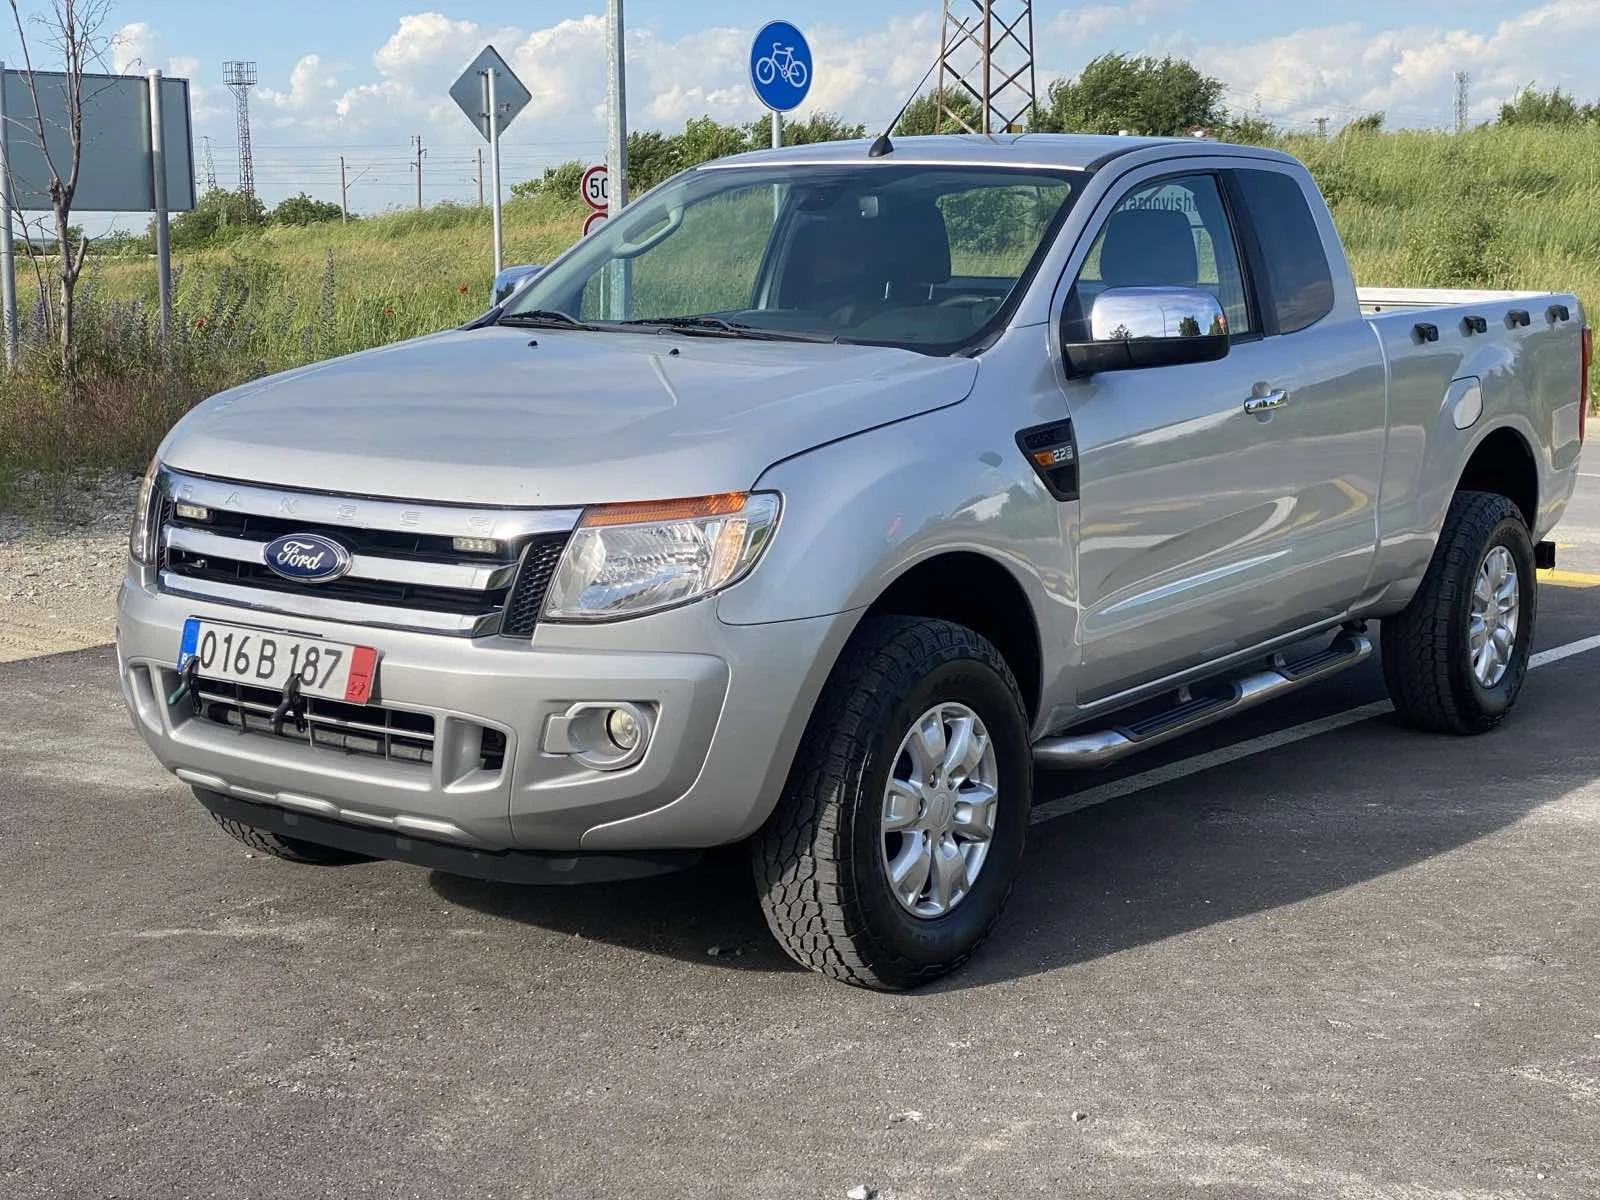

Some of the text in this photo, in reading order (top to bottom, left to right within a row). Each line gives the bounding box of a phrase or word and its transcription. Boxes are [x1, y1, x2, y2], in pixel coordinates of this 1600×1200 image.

[277, 541, 325, 570] Ford
[200, 630, 343, 689] 016 B 187
